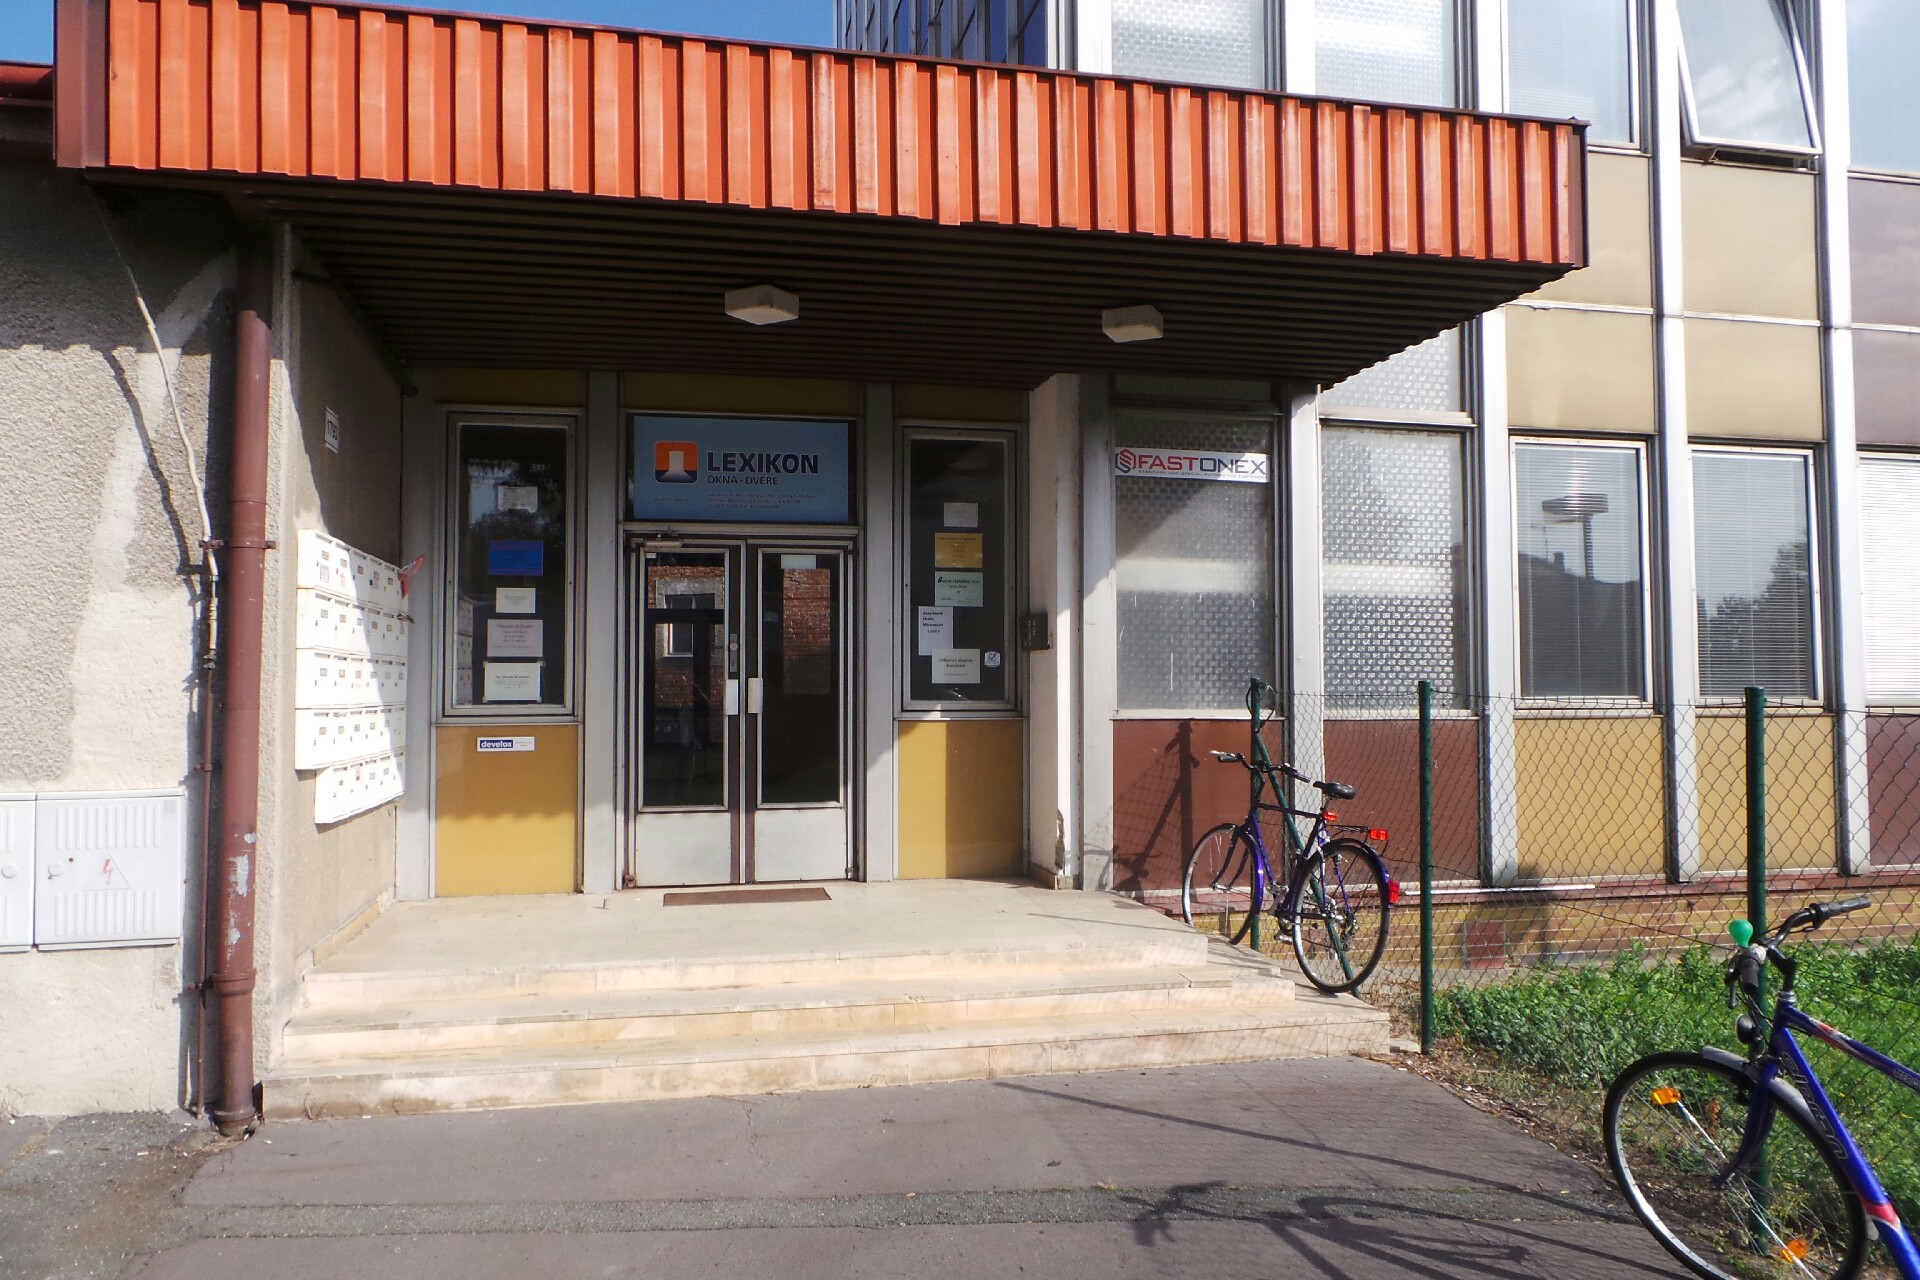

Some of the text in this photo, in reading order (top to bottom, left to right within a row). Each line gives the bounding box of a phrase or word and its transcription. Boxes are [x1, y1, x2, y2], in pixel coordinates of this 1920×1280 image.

[707, 451, 818, 474] LEXIKON
[1138, 454, 1267, 475] FASTONEX
[707, 475, 738, 484] OKNA
[481, 740, 513, 748] develox
